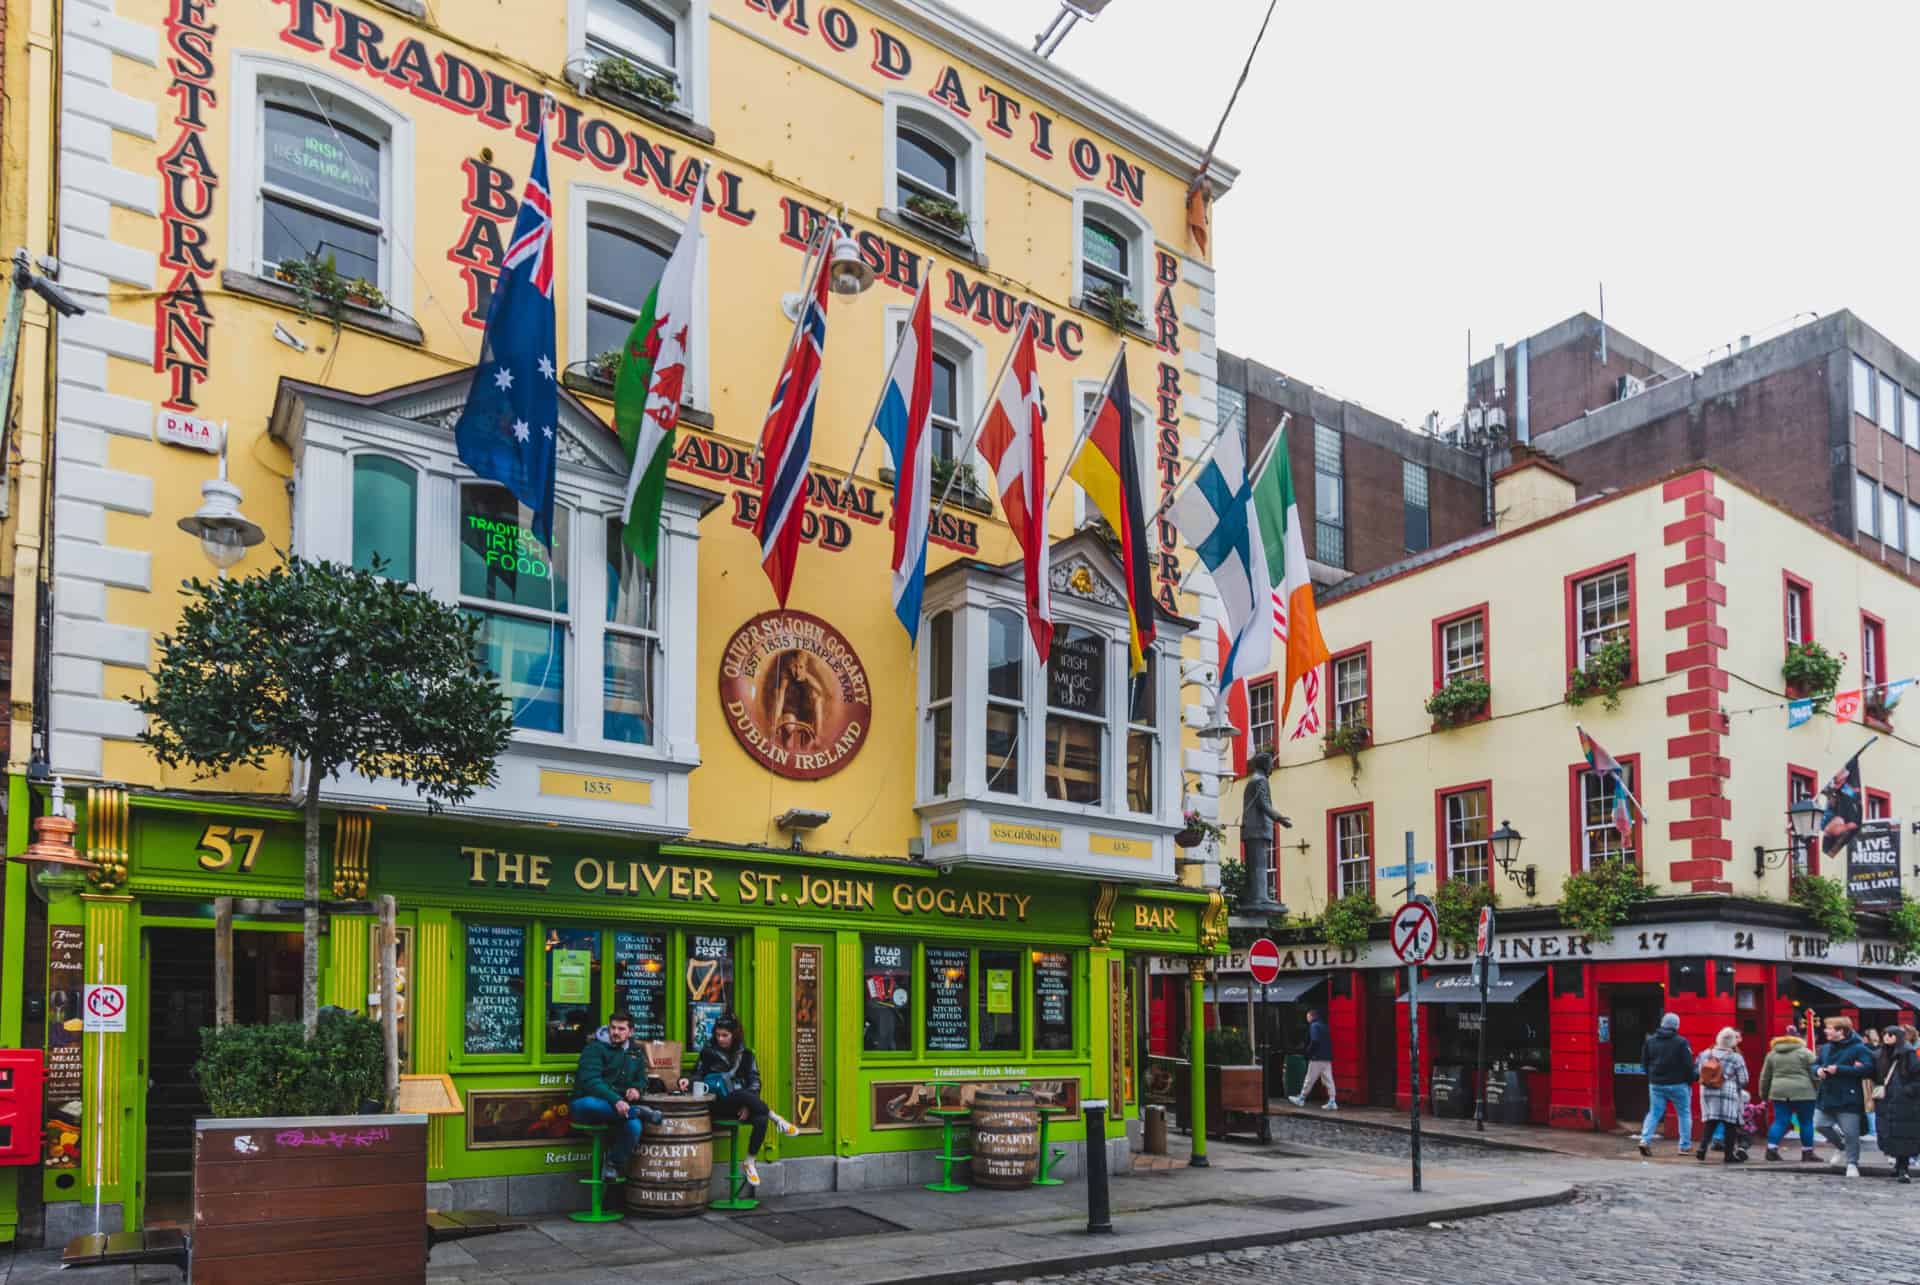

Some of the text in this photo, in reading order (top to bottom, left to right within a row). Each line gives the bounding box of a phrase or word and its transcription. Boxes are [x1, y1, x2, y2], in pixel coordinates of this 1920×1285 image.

[1155, 251, 1180, 356] BAR
[467, 513, 560, 548] TRADITIOL
[732, 490, 852, 552] FOD
[486, 531, 543, 560] IRISH
[486, 549, 546, 577] FOOD
[724, 625, 763, 678] OLIVER
[784, 617, 825, 643] JOHN
[825, 636, 869, 705] GOGARTY
[792, 636, 843, 674] TEMPLE
[728, 700, 862, 769] DUBLIN IRELAND
[199, 823, 264, 872] 57
[1851, 851, 1896, 864] MUSIC
[1856, 836, 1891, 852] LIVE
[461, 846, 1031, 922] THE OLIVER ST. JOHN GOGARTY
[1849, 878, 1900, 891] TILL LATE
[1135, 903, 1180, 932] BAR
[473, 947, 518, 957] WAITING
[1638, 932, 1668, 950] 17
[480, 957, 510, 965] STAFF
[539, 1073, 561, 1086] Bar
[935, 1067, 980, 1076] Traditional
[978, 1131, 1033, 1145] GOGARTY
[642, 1190, 685, 1201] DUBLIN
